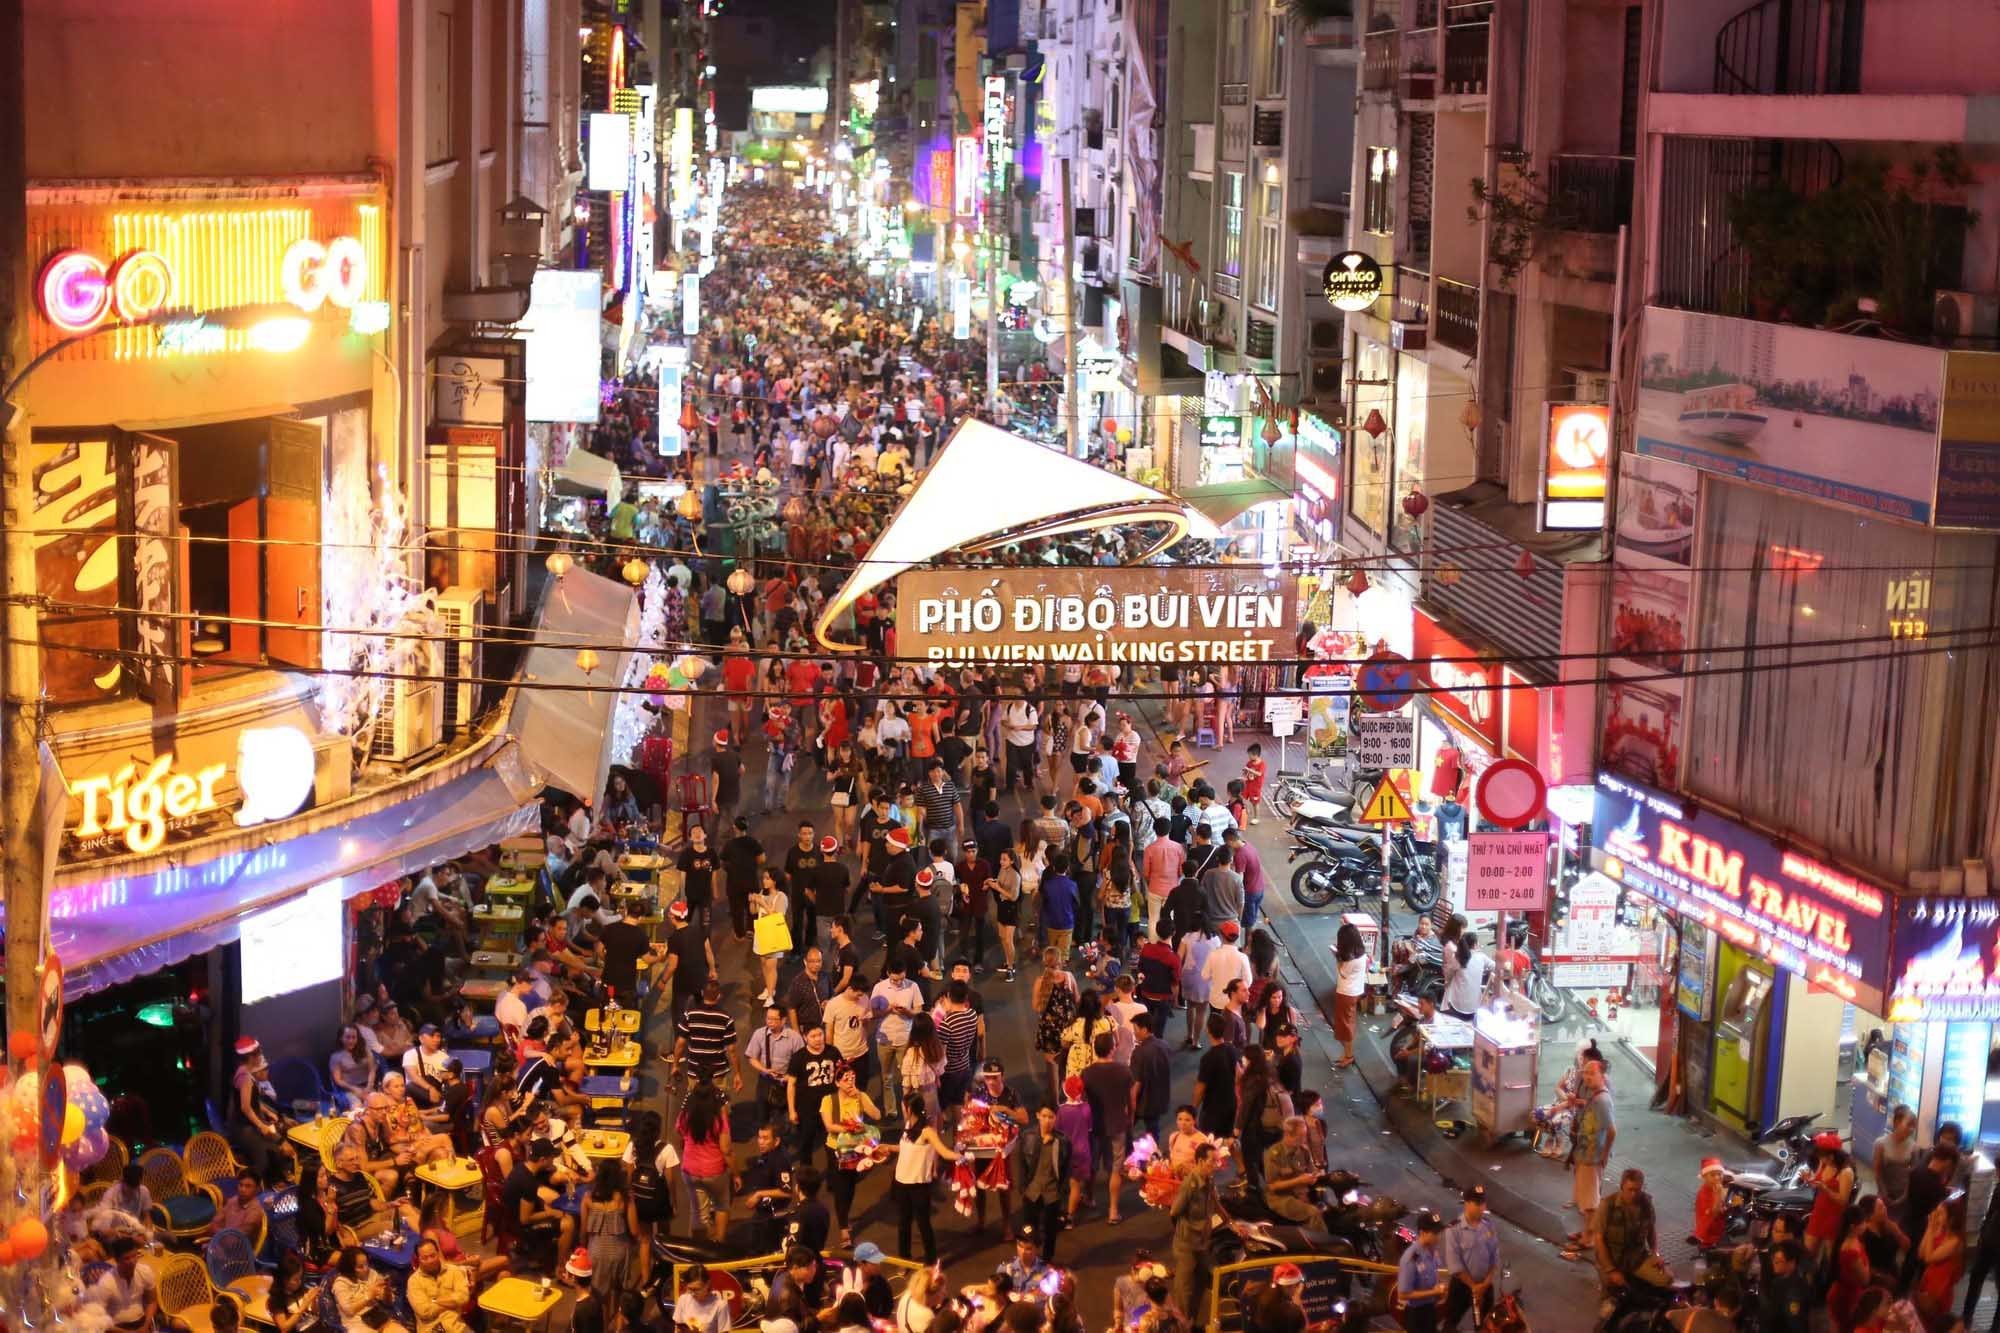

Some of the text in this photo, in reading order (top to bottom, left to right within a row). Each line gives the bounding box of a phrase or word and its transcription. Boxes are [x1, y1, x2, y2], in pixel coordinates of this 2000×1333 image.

[39, 247, 173, 334] GO
[1329, 271, 1376, 283] GINKGO
[919, 578, 1002, 633] PHỐ
[1123, 586, 1190, 629] BÙI
[928, 645, 975, 669] BUI
[982, 643, 1046, 667] VIEN
[1178, 639, 1274, 662] STREET
[1363, 737, 1381, 748] 9:00
[1390, 738, 1411, 748] 16:00
[1362, 753, 1383, 764] 19:00
[1393, 753, 1411, 764] 6:00
[69, 753, 228, 853] Tiger
[80, 835, 114, 852] SINCE
[1489, 844, 1494, 855] 7
[1657, 820, 1745, 898] KIM
[1747, 875, 1852, 954] TRAVEL
[805, 1060, 837, 1087] 23
